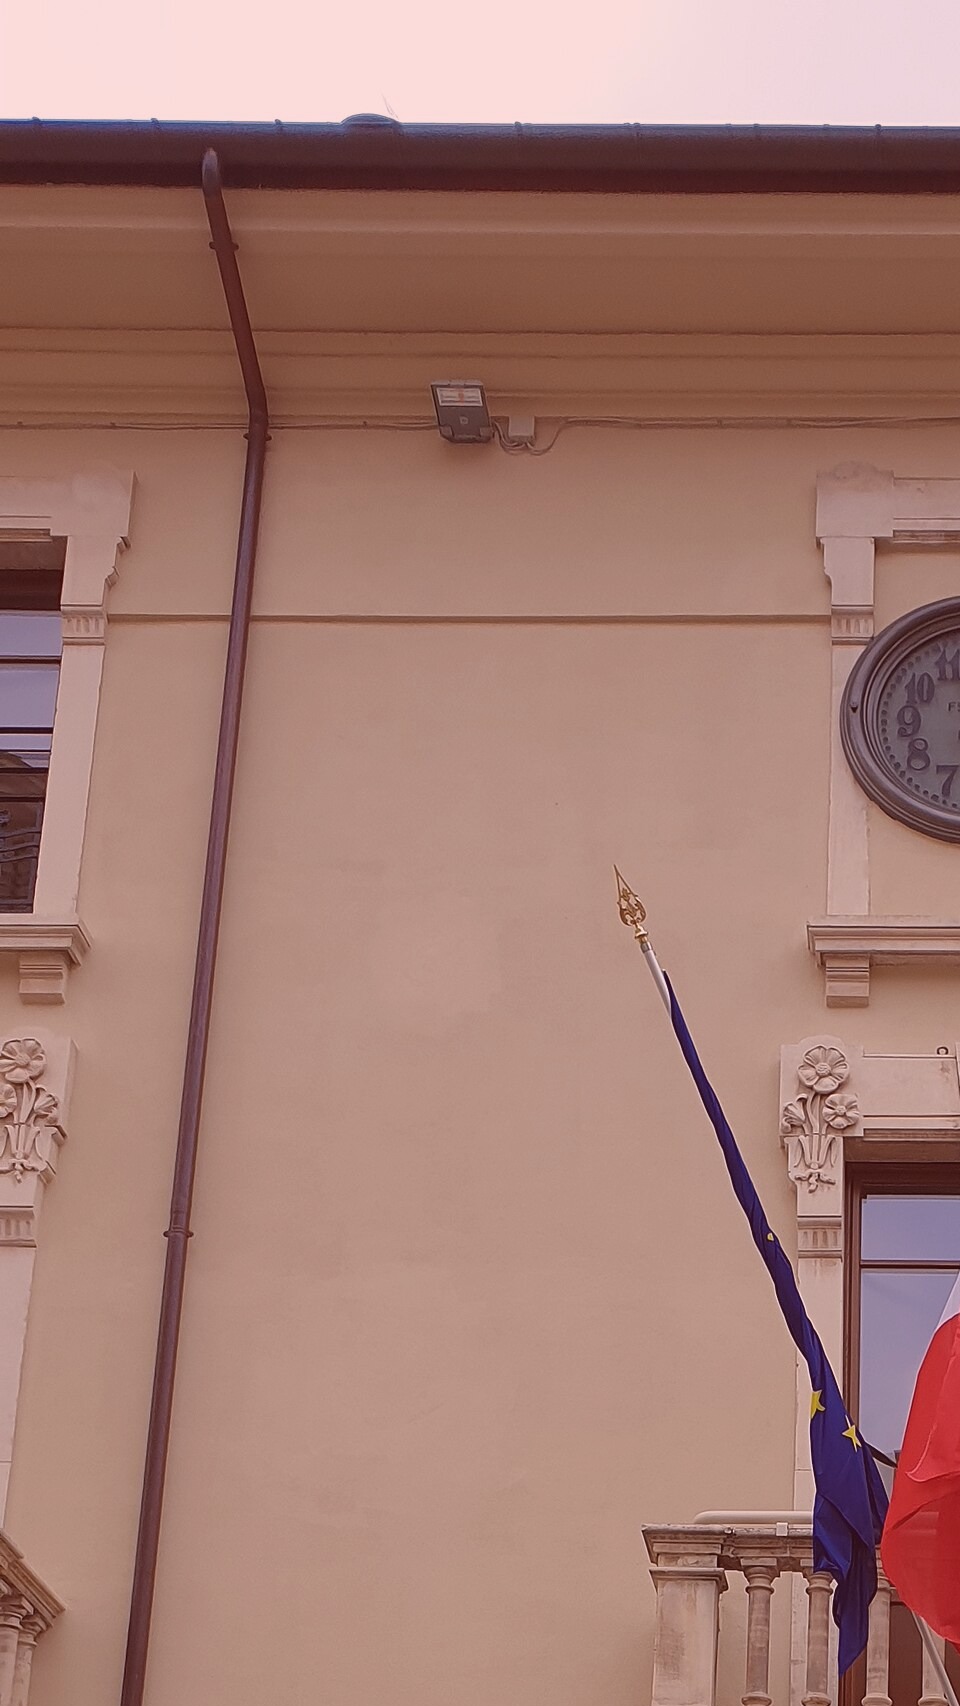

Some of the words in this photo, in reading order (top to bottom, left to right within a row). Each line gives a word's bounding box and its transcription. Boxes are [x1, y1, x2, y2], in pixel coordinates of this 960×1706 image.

[935, 648, 960, 681] 11
[905, 672, 935, 704] 10
[897, 705, 921, 737] 9
[907, 738, 930, 771] 8
[936, 764, 960, 797] 7
